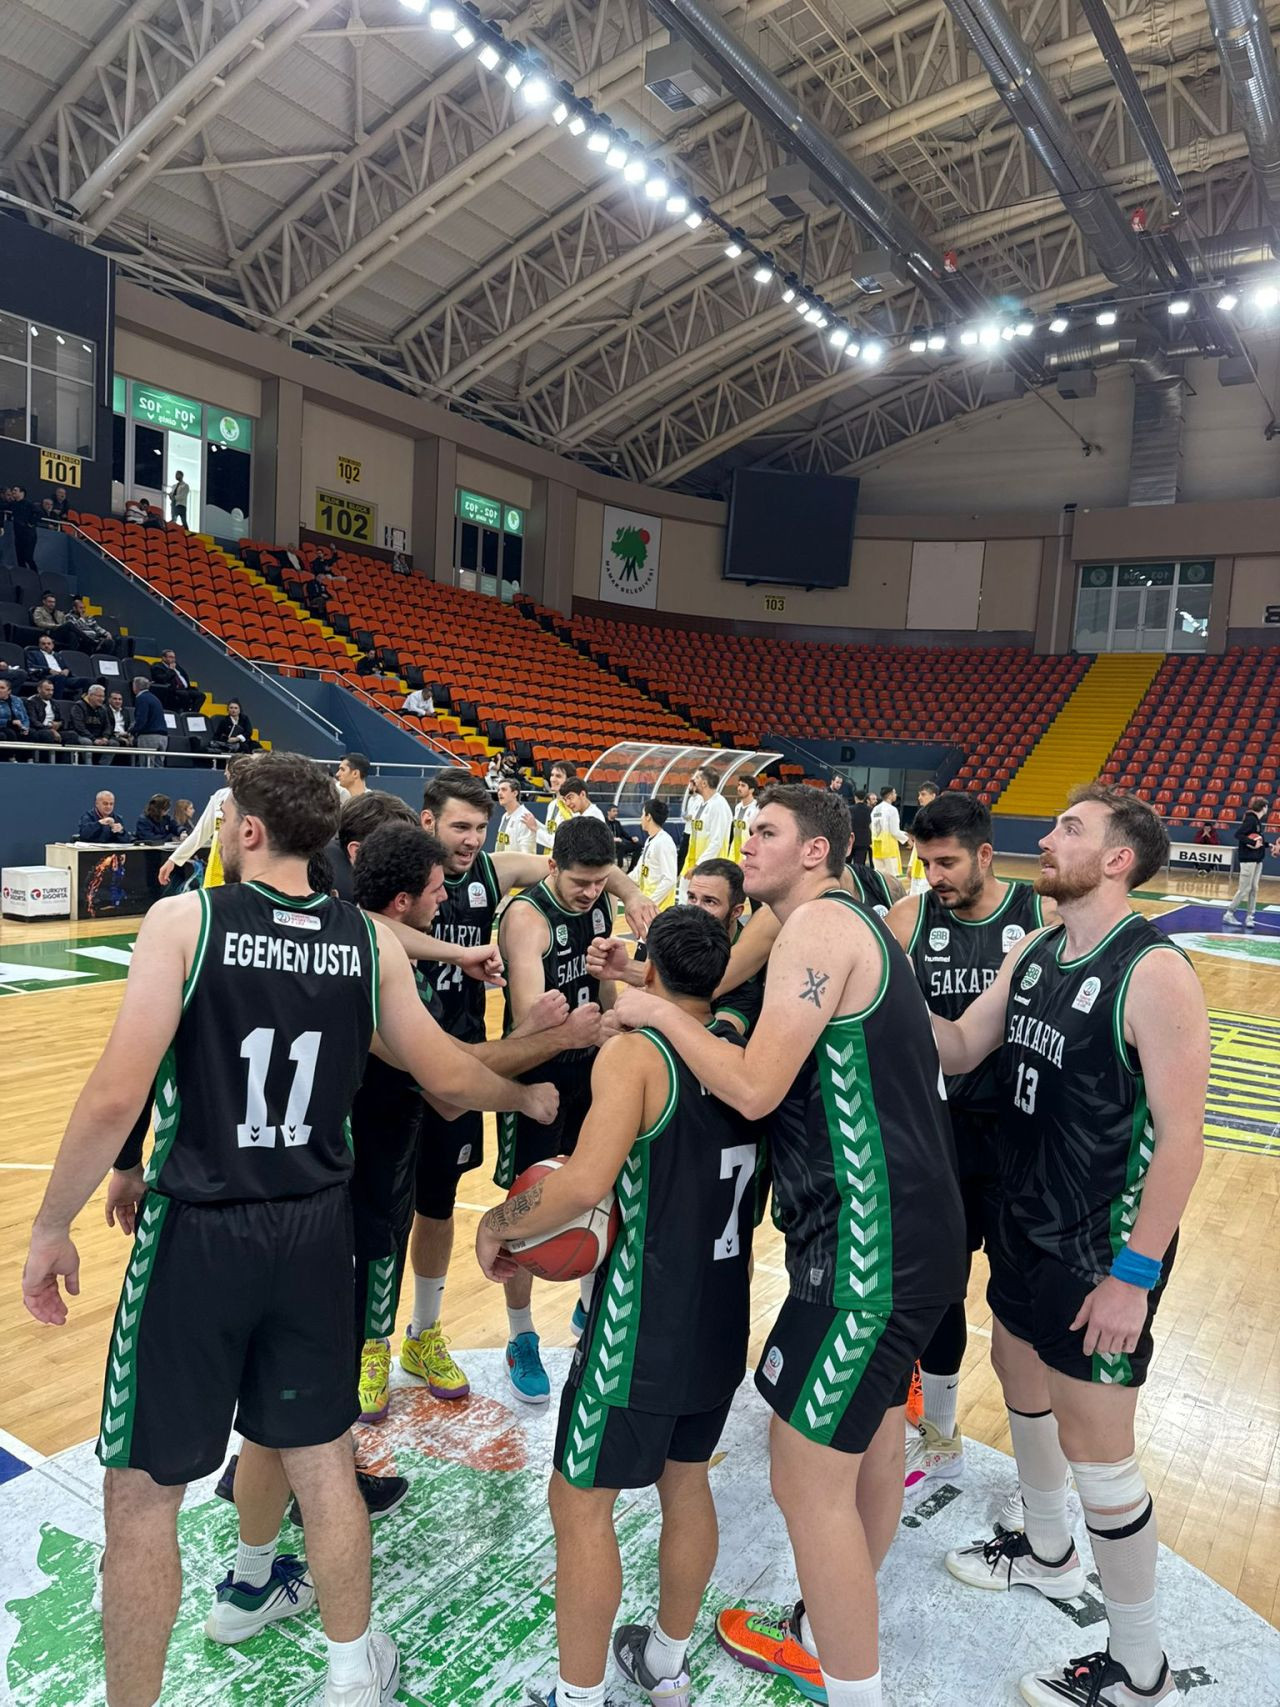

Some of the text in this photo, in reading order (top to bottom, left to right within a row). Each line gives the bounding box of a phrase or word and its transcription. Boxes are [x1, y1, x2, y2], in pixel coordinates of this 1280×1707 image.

[45, 459, 76, 485] 101
[339, 462, 360, 482] 102
[321, 505, 368, 540] 102
[765, 599, 785, 611] 103
[841, 746, 856, 762] D
[1179, 851, 1223, 863] BASIN
[435, 923, 481, 947] AKARYA
[931, 931, 948, 940] SBB
[223, 931, 362, 977] EGEMEN USTA
[924, 954, 951, 962] hummel
[1008, 1014, 1065, 1070] SAKARYA
[237, 1027, 322, 1148] 11
[1013, 1062, 1039, 1115] 13
[713, 1143, 757, 1261] 7
